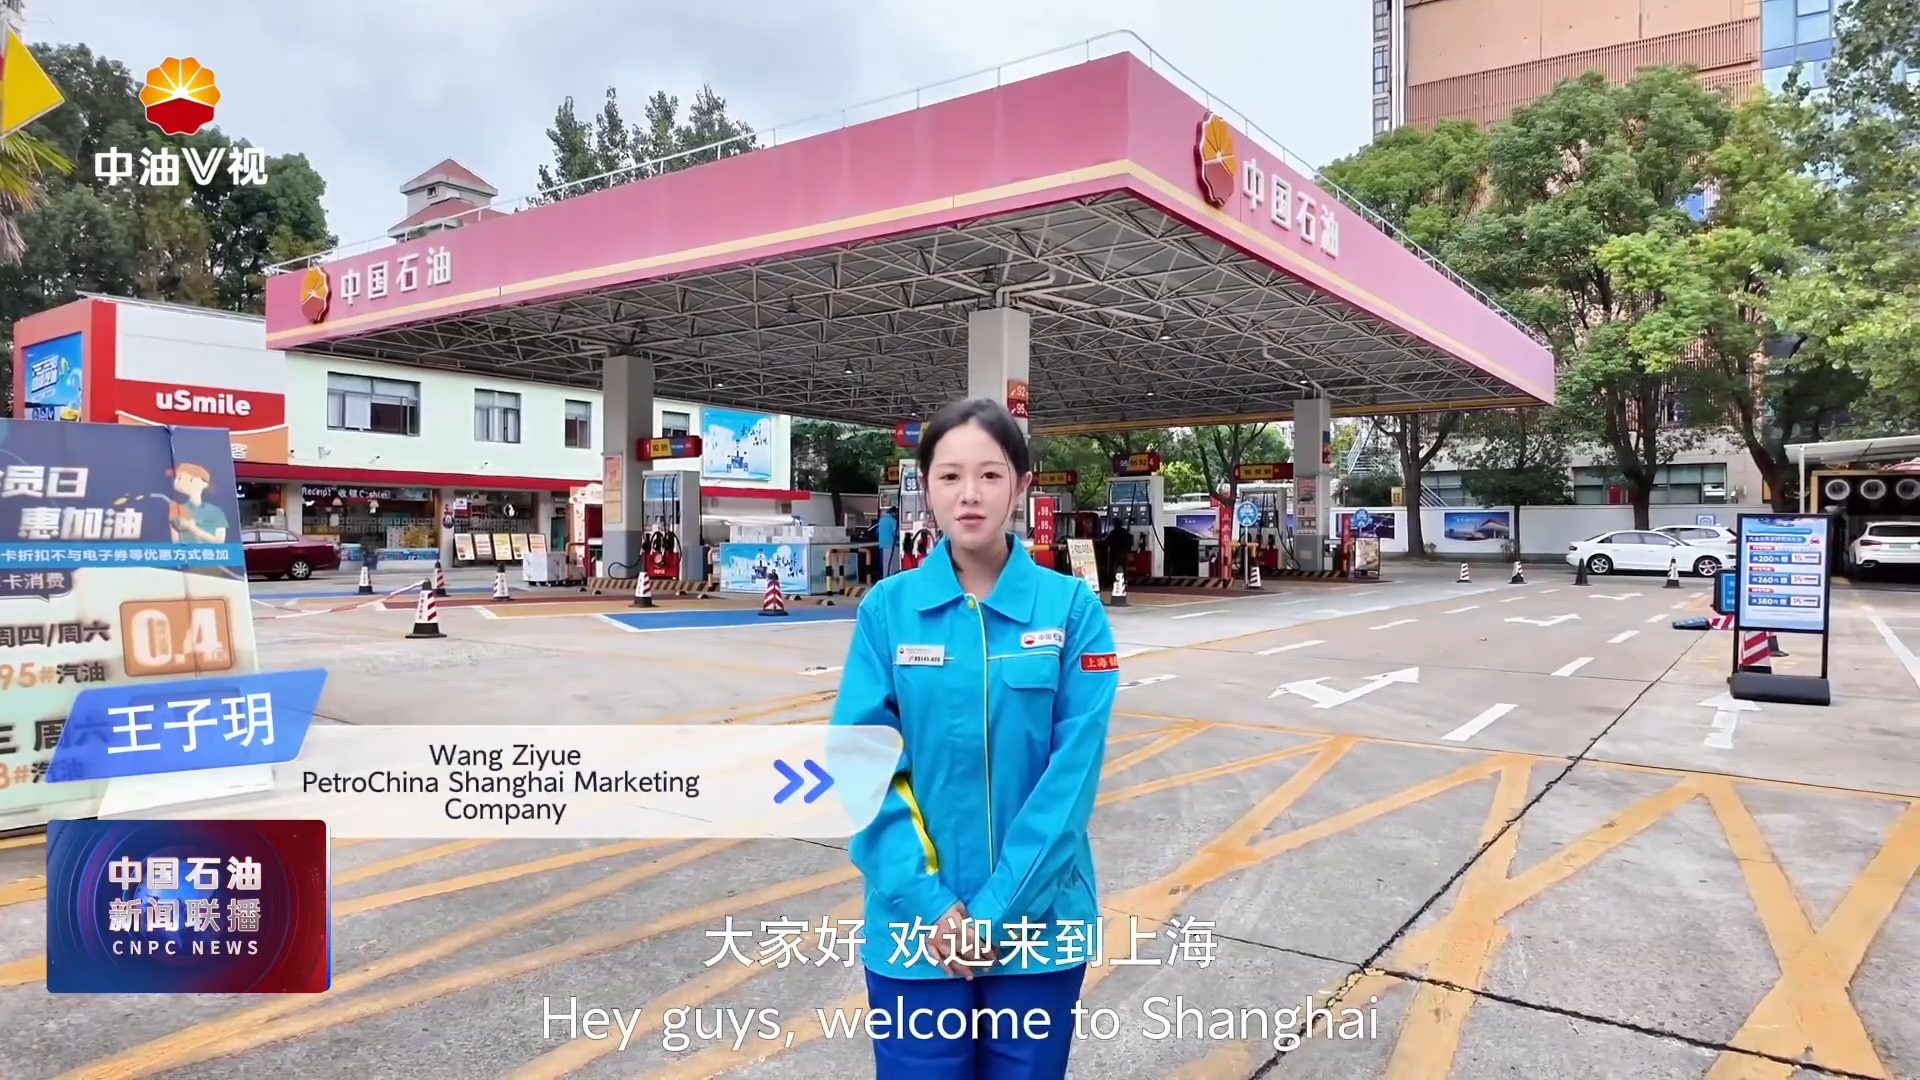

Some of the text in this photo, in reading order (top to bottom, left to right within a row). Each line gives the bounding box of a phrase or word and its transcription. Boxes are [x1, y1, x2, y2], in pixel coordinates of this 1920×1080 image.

[1242, 158, 1339, 259] 中国石油
[340, 246, 453, 305] 中国石油
[155, 389, 252, 417] uSmile
[0, 465, 89, 499] 员日
[906, 477, 918, 491] 98
[17, 506, 144, 540] 惠加油
[3, 572, 66, 590] 卡消费
[131, 608, 224, 667] 0.4
